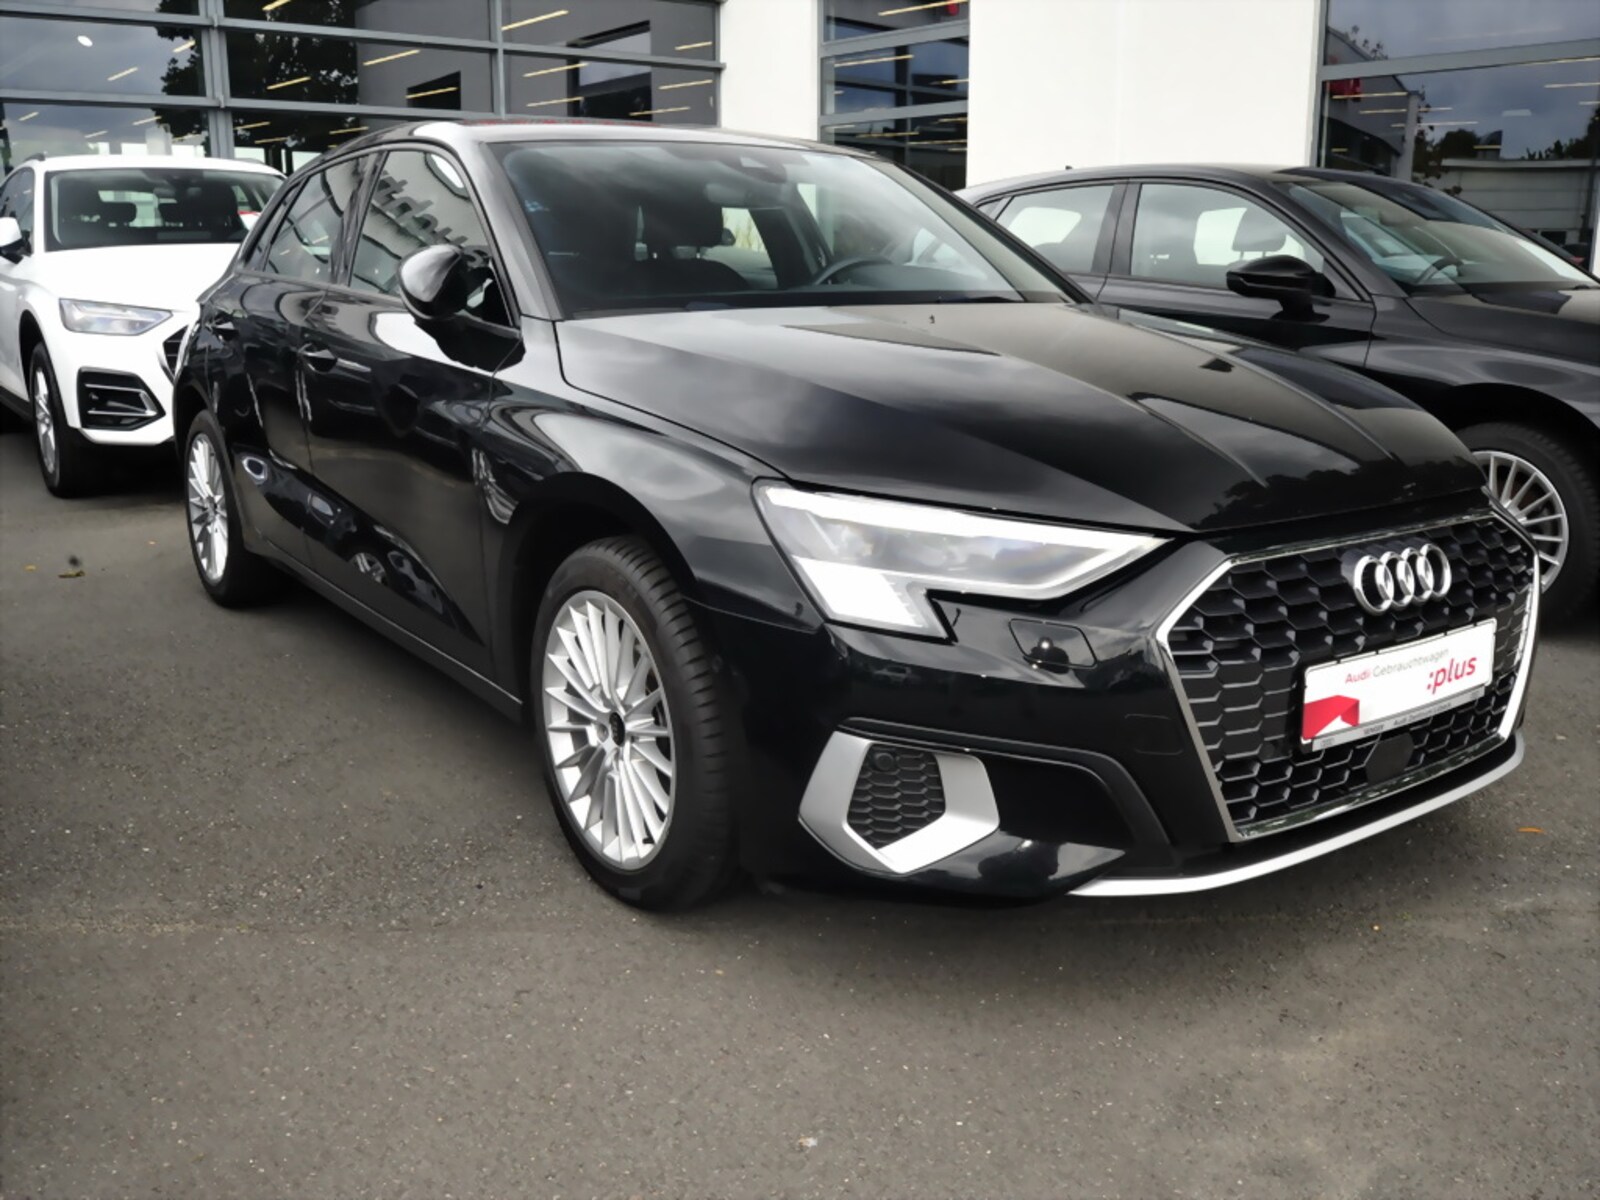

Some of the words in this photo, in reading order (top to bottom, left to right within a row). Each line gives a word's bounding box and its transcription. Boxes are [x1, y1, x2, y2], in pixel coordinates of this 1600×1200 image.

[1345, 670, 1371, 684] Audi
[1372, 649, 1449, 678] Gebrauchtwagen
[1427, 657, 1477, 695] :plus
